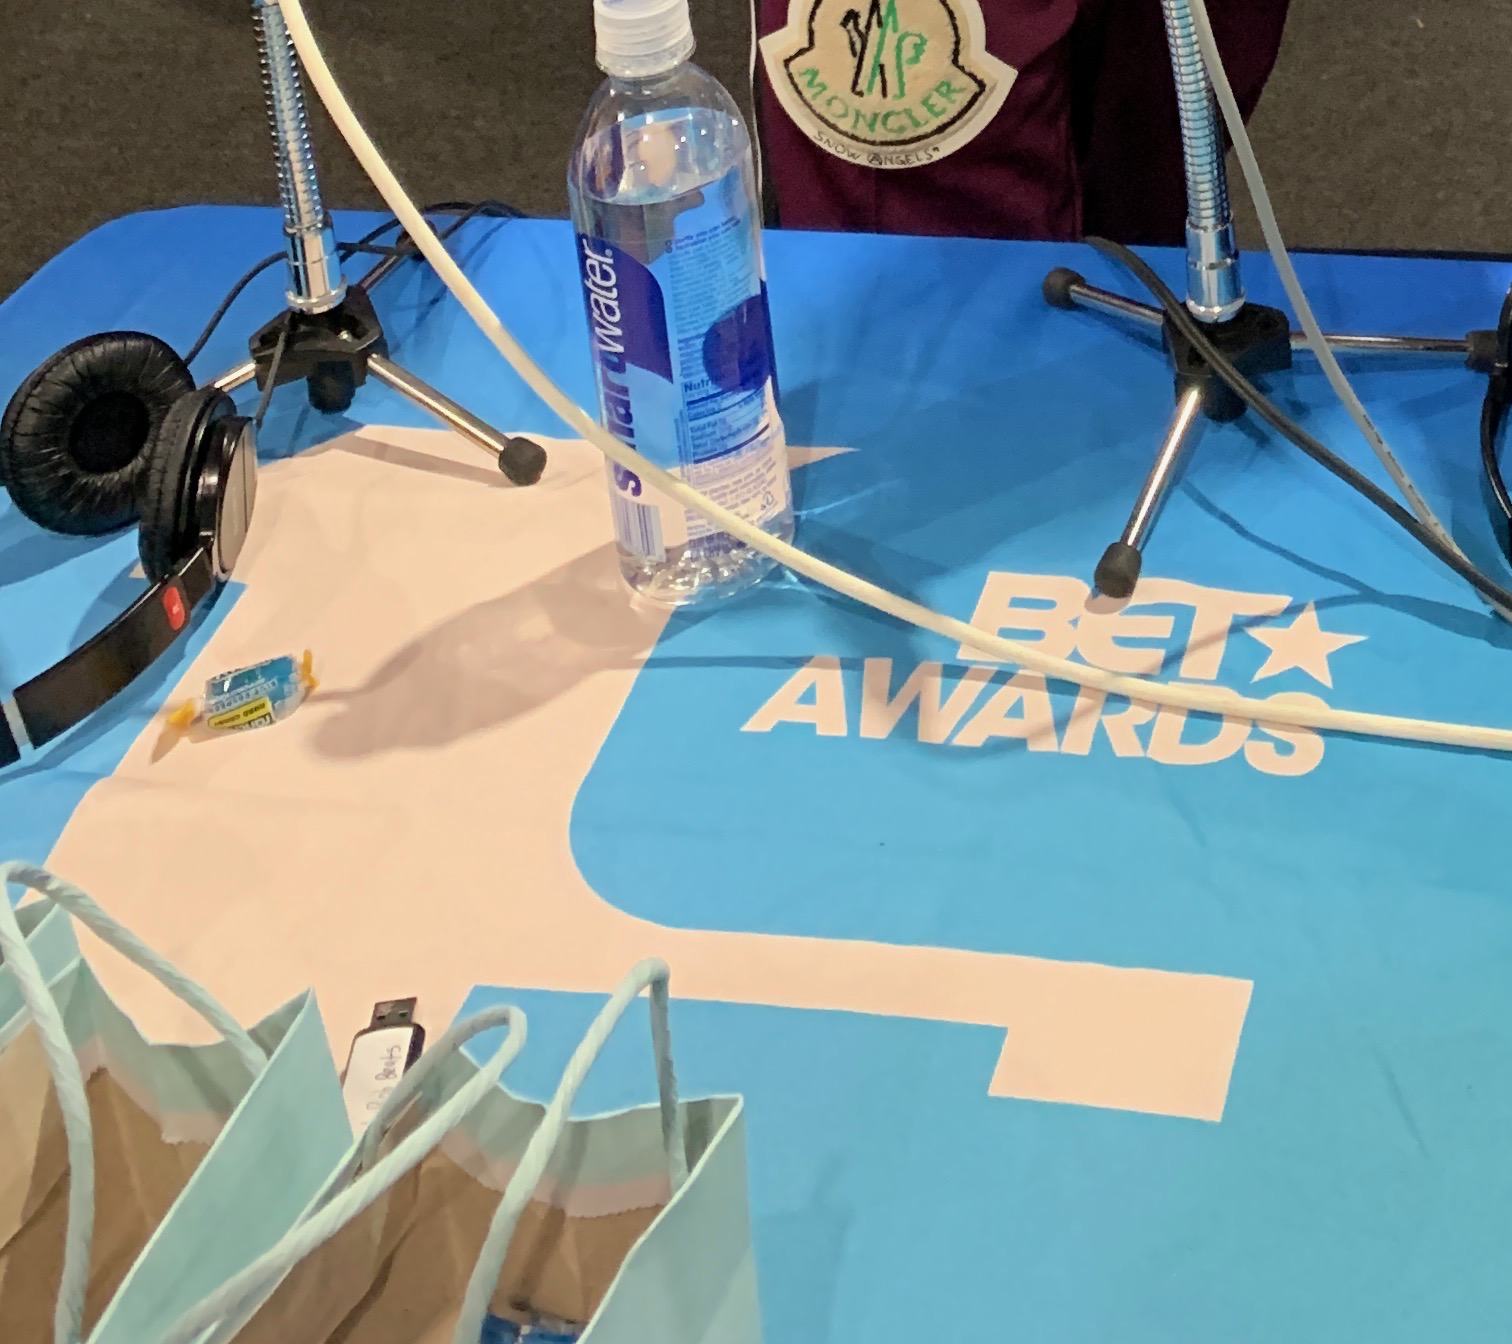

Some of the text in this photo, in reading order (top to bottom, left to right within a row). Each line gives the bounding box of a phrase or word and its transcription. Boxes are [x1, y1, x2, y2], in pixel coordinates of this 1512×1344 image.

[798, 67, 968, 135] MONCLER
[812, 129, 860, 162] SNOW
[956, 570, 1294, 682] BET
[739, 655, 1333, 777] AWARDS
